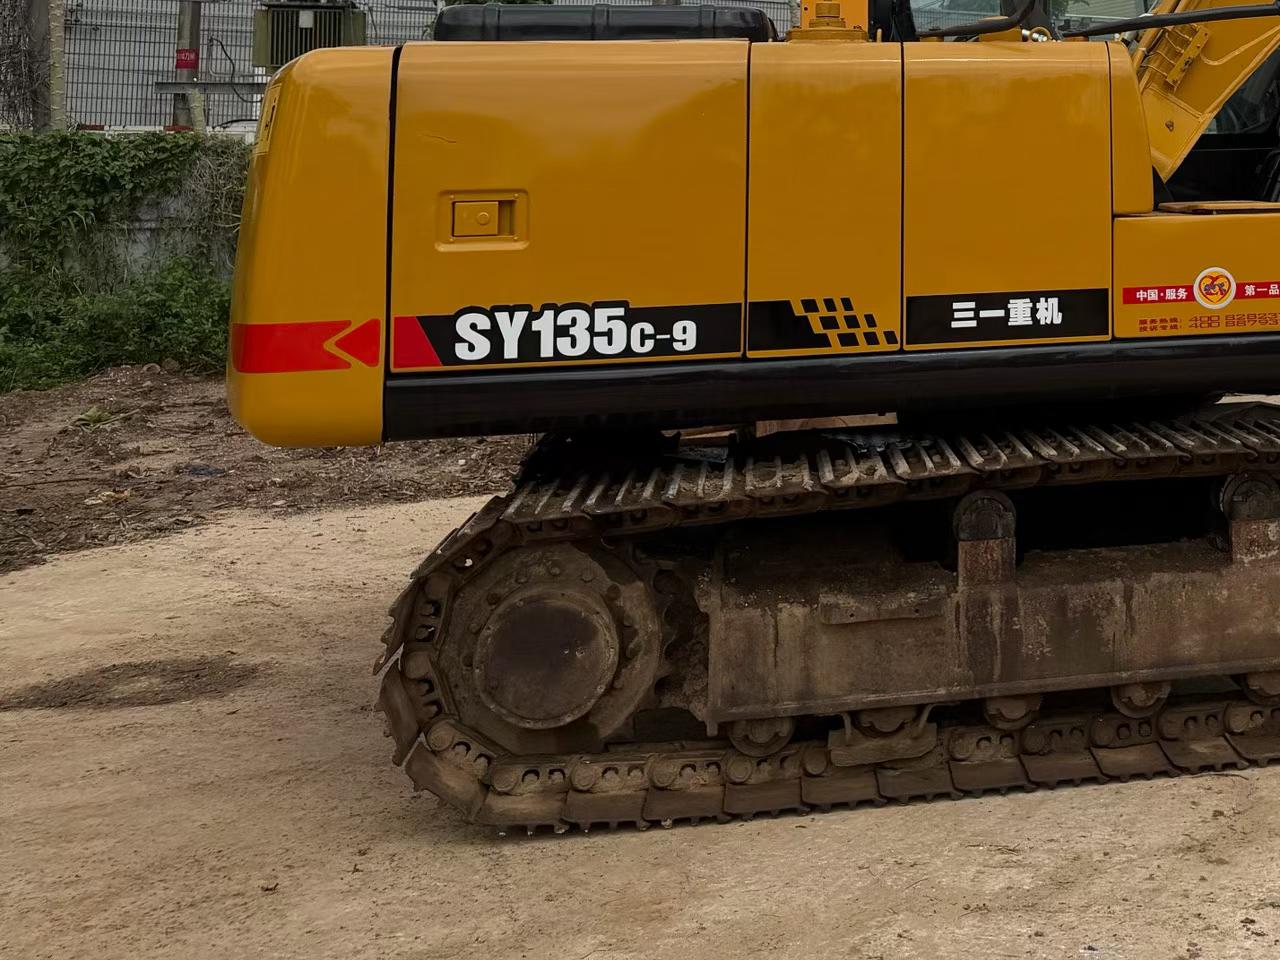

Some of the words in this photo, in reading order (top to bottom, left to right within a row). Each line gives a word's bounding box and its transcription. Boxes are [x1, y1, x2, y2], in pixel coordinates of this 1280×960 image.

[951, 297, 1063, 328] 三一重机
[1188, 321, 1220, 329] 400
[454, 307, 698, 361] SY135C-9
